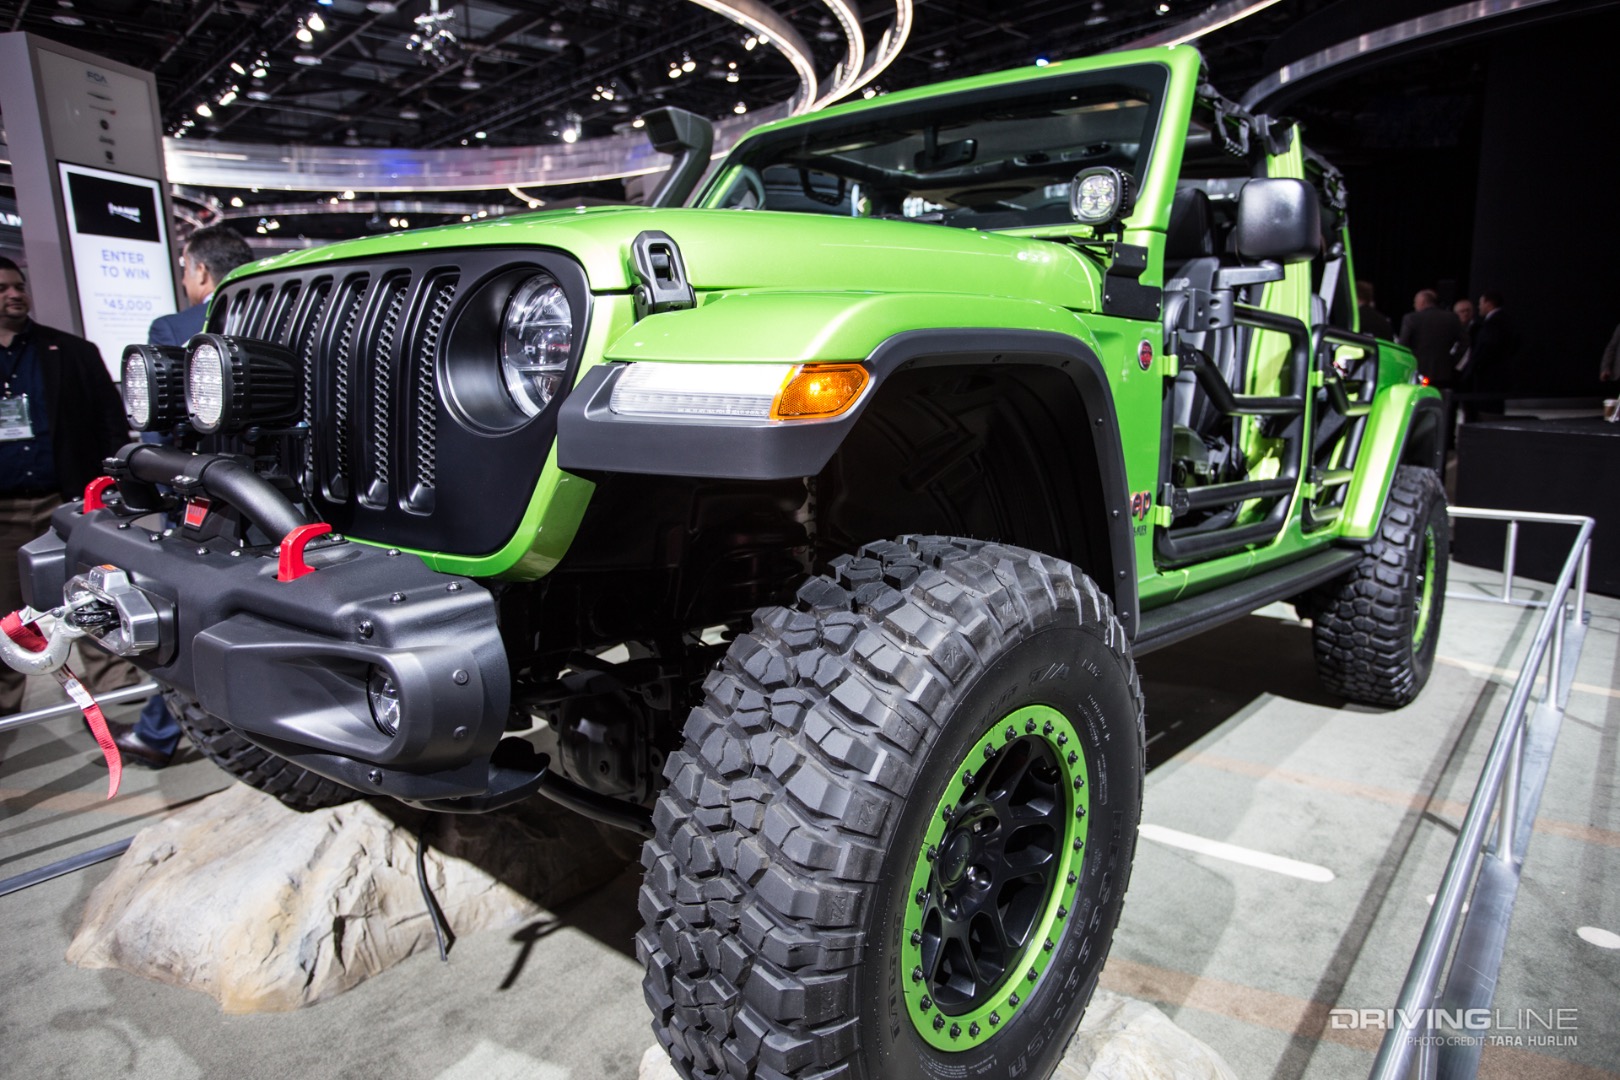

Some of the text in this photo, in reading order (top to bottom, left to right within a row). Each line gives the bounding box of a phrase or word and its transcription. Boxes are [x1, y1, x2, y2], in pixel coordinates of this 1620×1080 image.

[0, 211, 22, 227] AM
[101, 249, 145, 264] ENTER
[100, 265, 150, 280] TO WIN
[1130, 490, 1152, 521] ep
